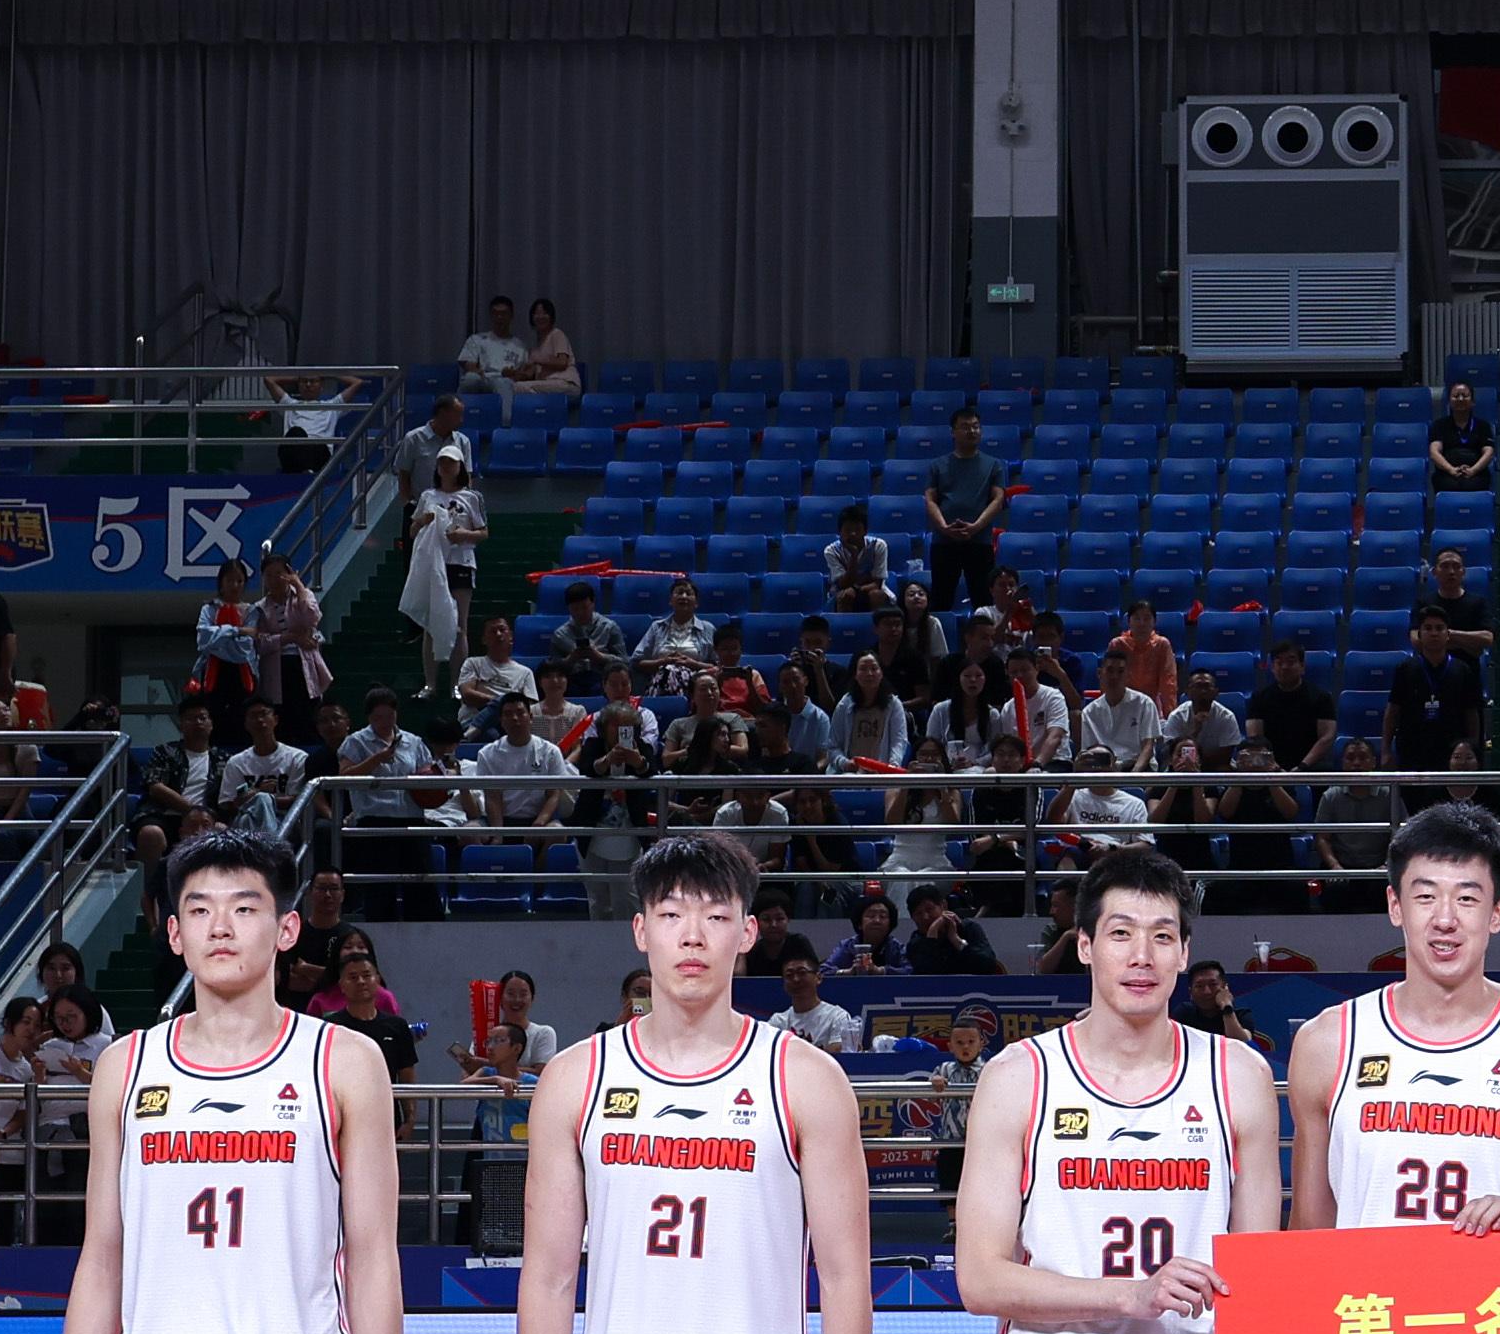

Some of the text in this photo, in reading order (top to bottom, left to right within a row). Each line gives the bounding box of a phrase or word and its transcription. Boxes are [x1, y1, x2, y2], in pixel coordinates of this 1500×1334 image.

[1080, 811, 1120, 824] adidas
[277, 1112, 296, 1121] CGB
[732, 1117, 751, 1126] CGB
[140, 1130, 297, 1165] GUANGDONG
[601, 1133, 756, 1172] GUANGDONG
[1186, 1135, 1205, 1143] CGB
[1058, 1157, 1211, 1191] GUANGDONG
[1394, 1157, 1468, 1222] 28
[186, 1186, 244, 1248] 41
[645, 1193, 705, 1259] 21
[1102, 1215, 1174, 1279] 20
